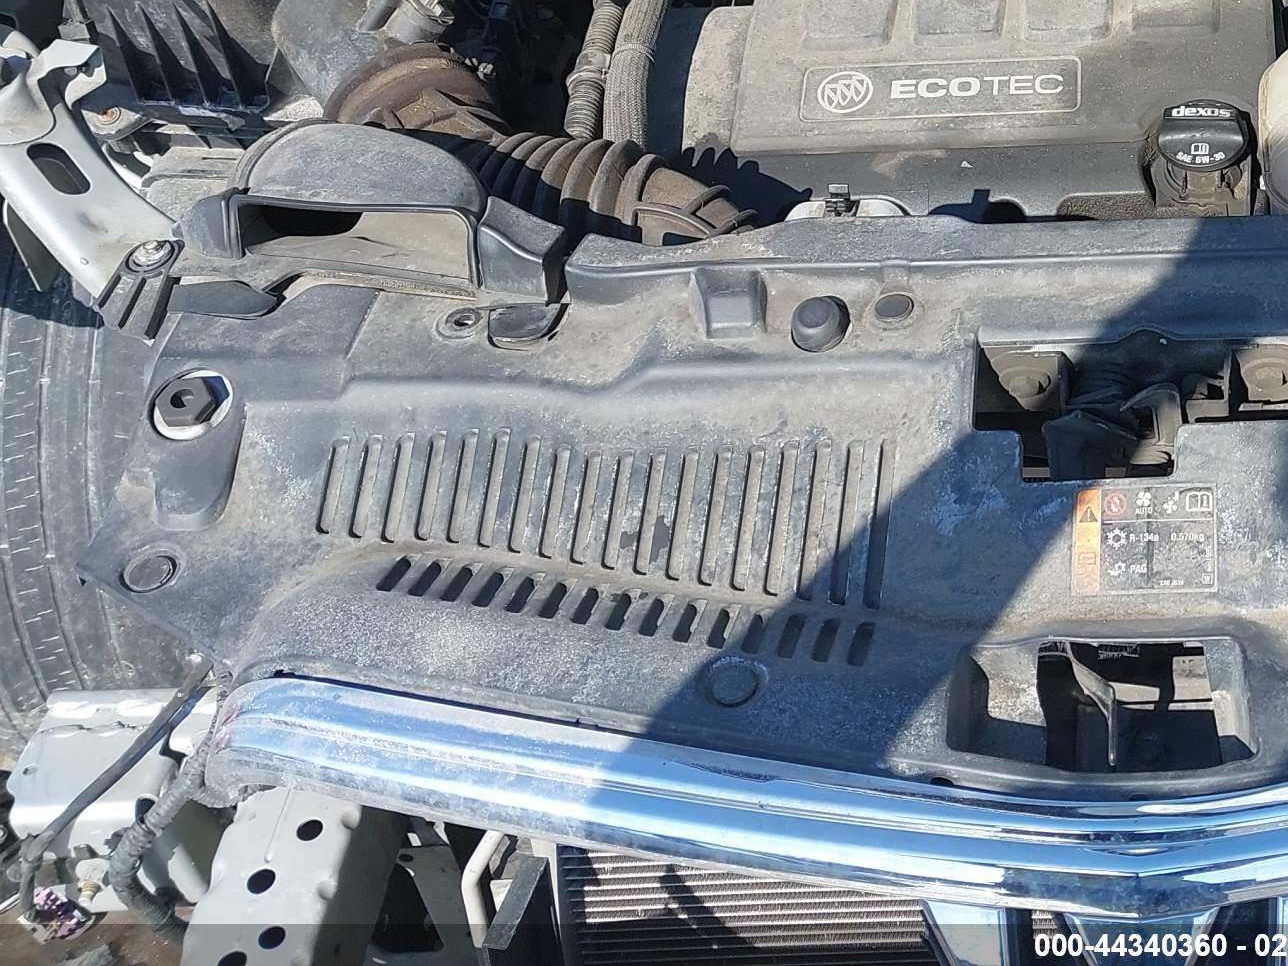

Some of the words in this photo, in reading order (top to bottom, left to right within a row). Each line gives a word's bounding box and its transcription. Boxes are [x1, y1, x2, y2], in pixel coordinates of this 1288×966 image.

[890, 75, 1064, 100] ECOTEC
[1171, 106, 1233, 118] dexos
[1176, 152, 1192, 163] SAE
[1135, 507, 1153, 515] AUTO
[1130, 533, 1159, 542] R-134a
[1130, 564, 1148, 574] PAG
